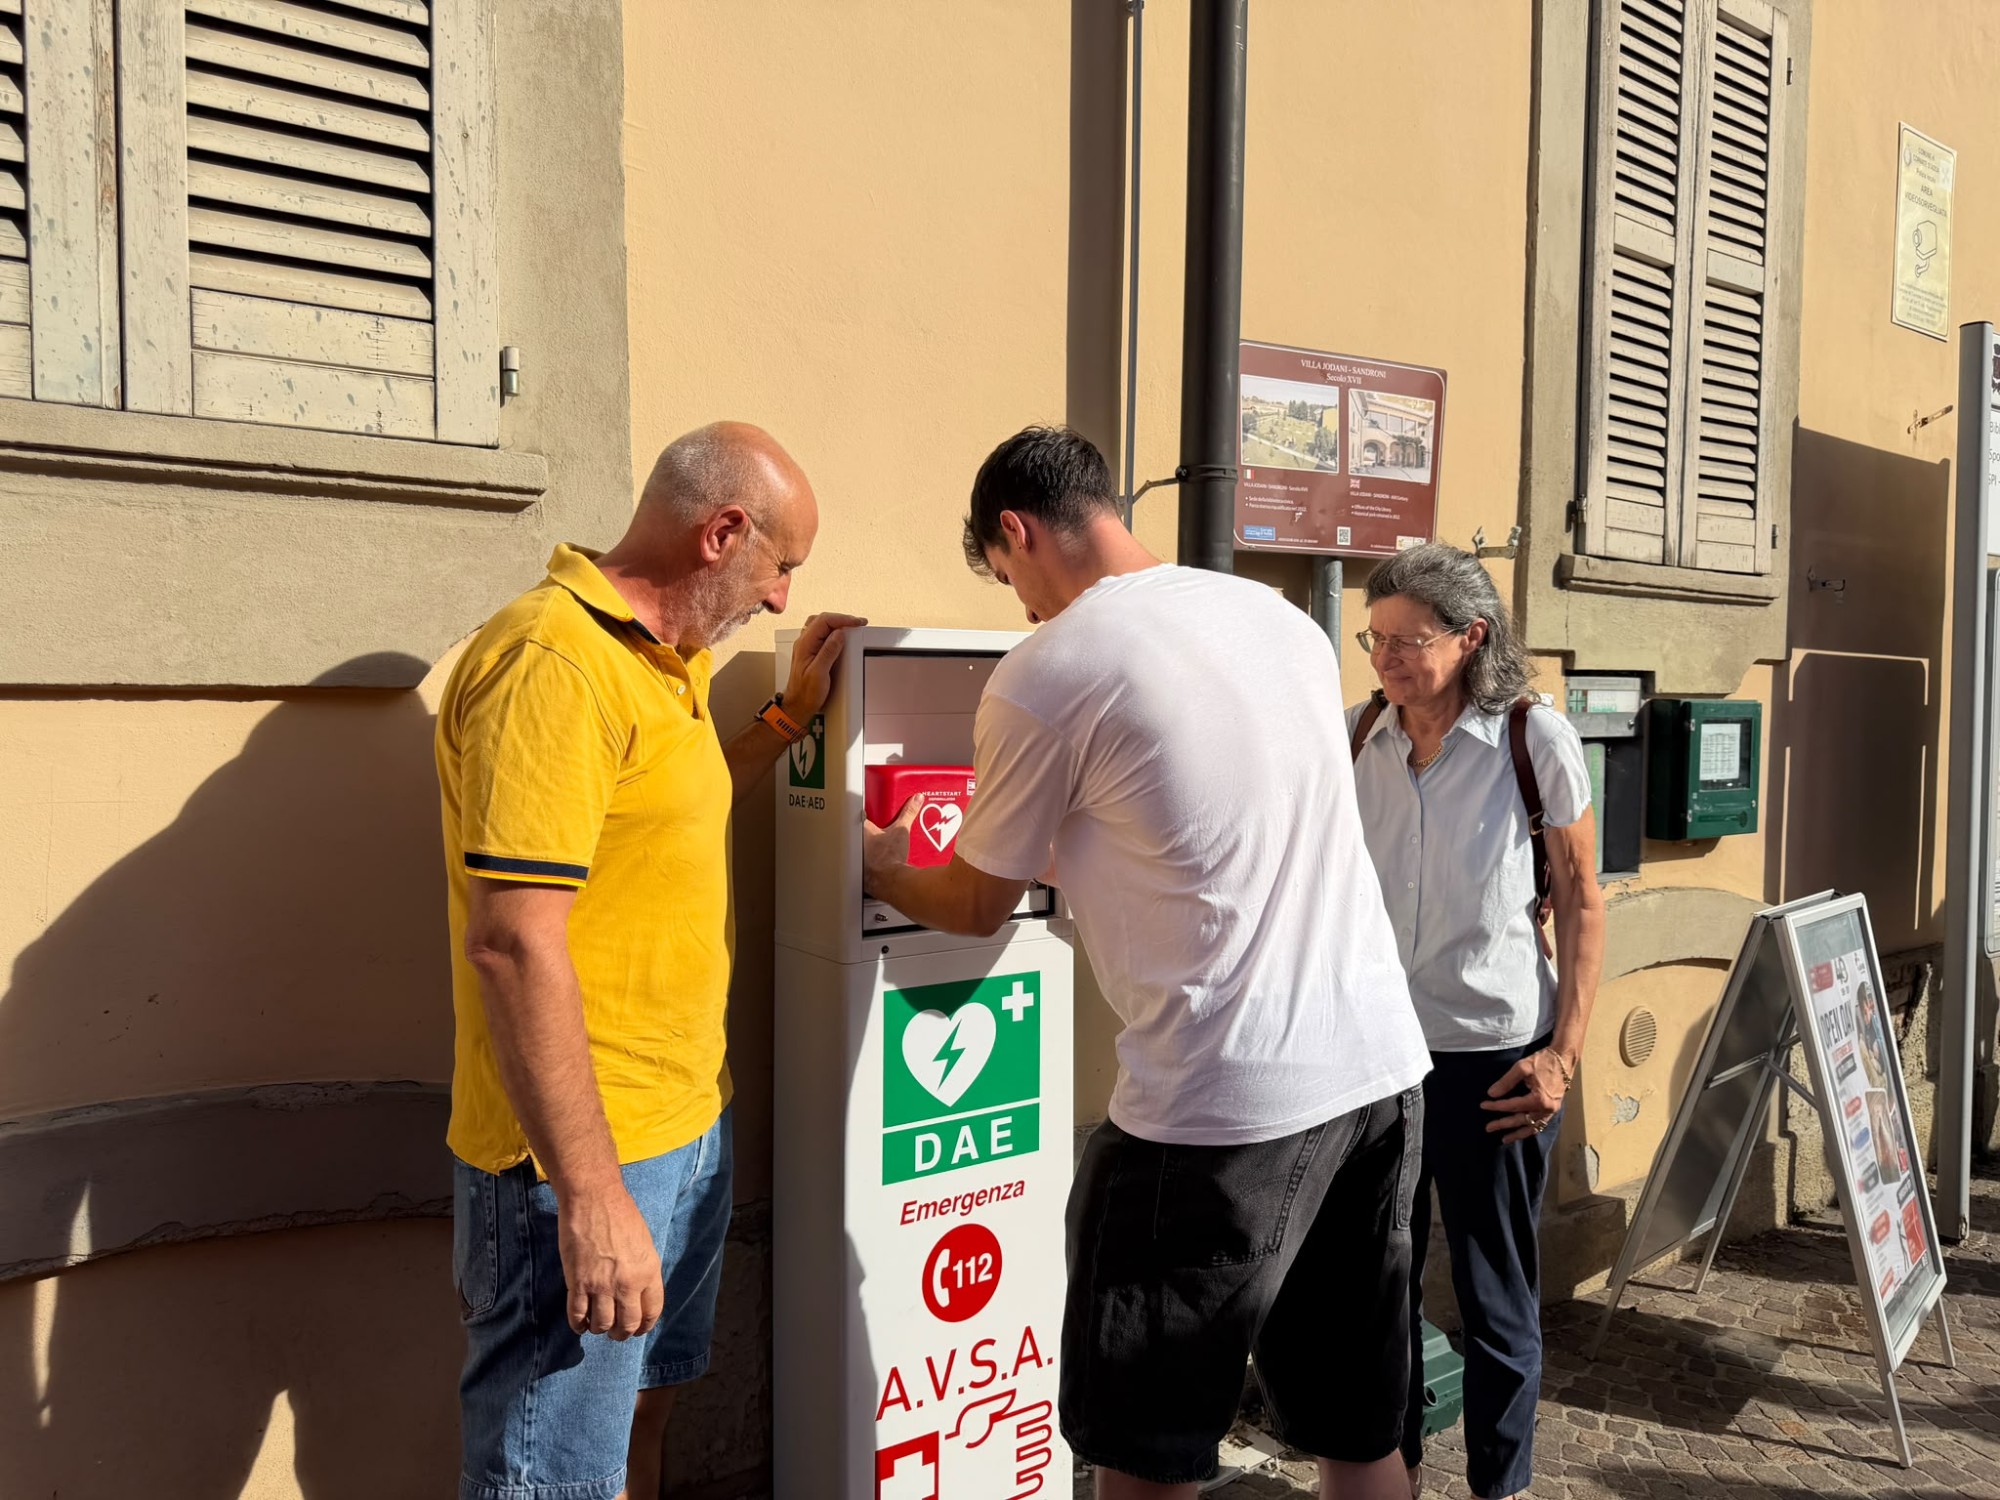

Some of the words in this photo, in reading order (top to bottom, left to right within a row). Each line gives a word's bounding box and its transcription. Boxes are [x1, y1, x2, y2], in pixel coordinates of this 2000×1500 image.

[1921, 185, 1933, 197] AREA
[1301, 359, 1321, 369] VILLA
[1322, 362, 1347, 373] JODANI
[1352, 366, 1386, 378] SANDRONI
[1326, 373, 1347, 382] Secolo
[1347, 375, 1362, 385] XVII
[1820, 1006, 1843, 1050] OPEN
[1840, 1000, 1855, 1038] DAY
[914, 1115, 1013, 1172] DAE
[900, 1180, 1025, 1226] Emergenza
[952, 1252, 993, 1289] 112
[875, 1325, 1053, 1422] A.V.S.A.
